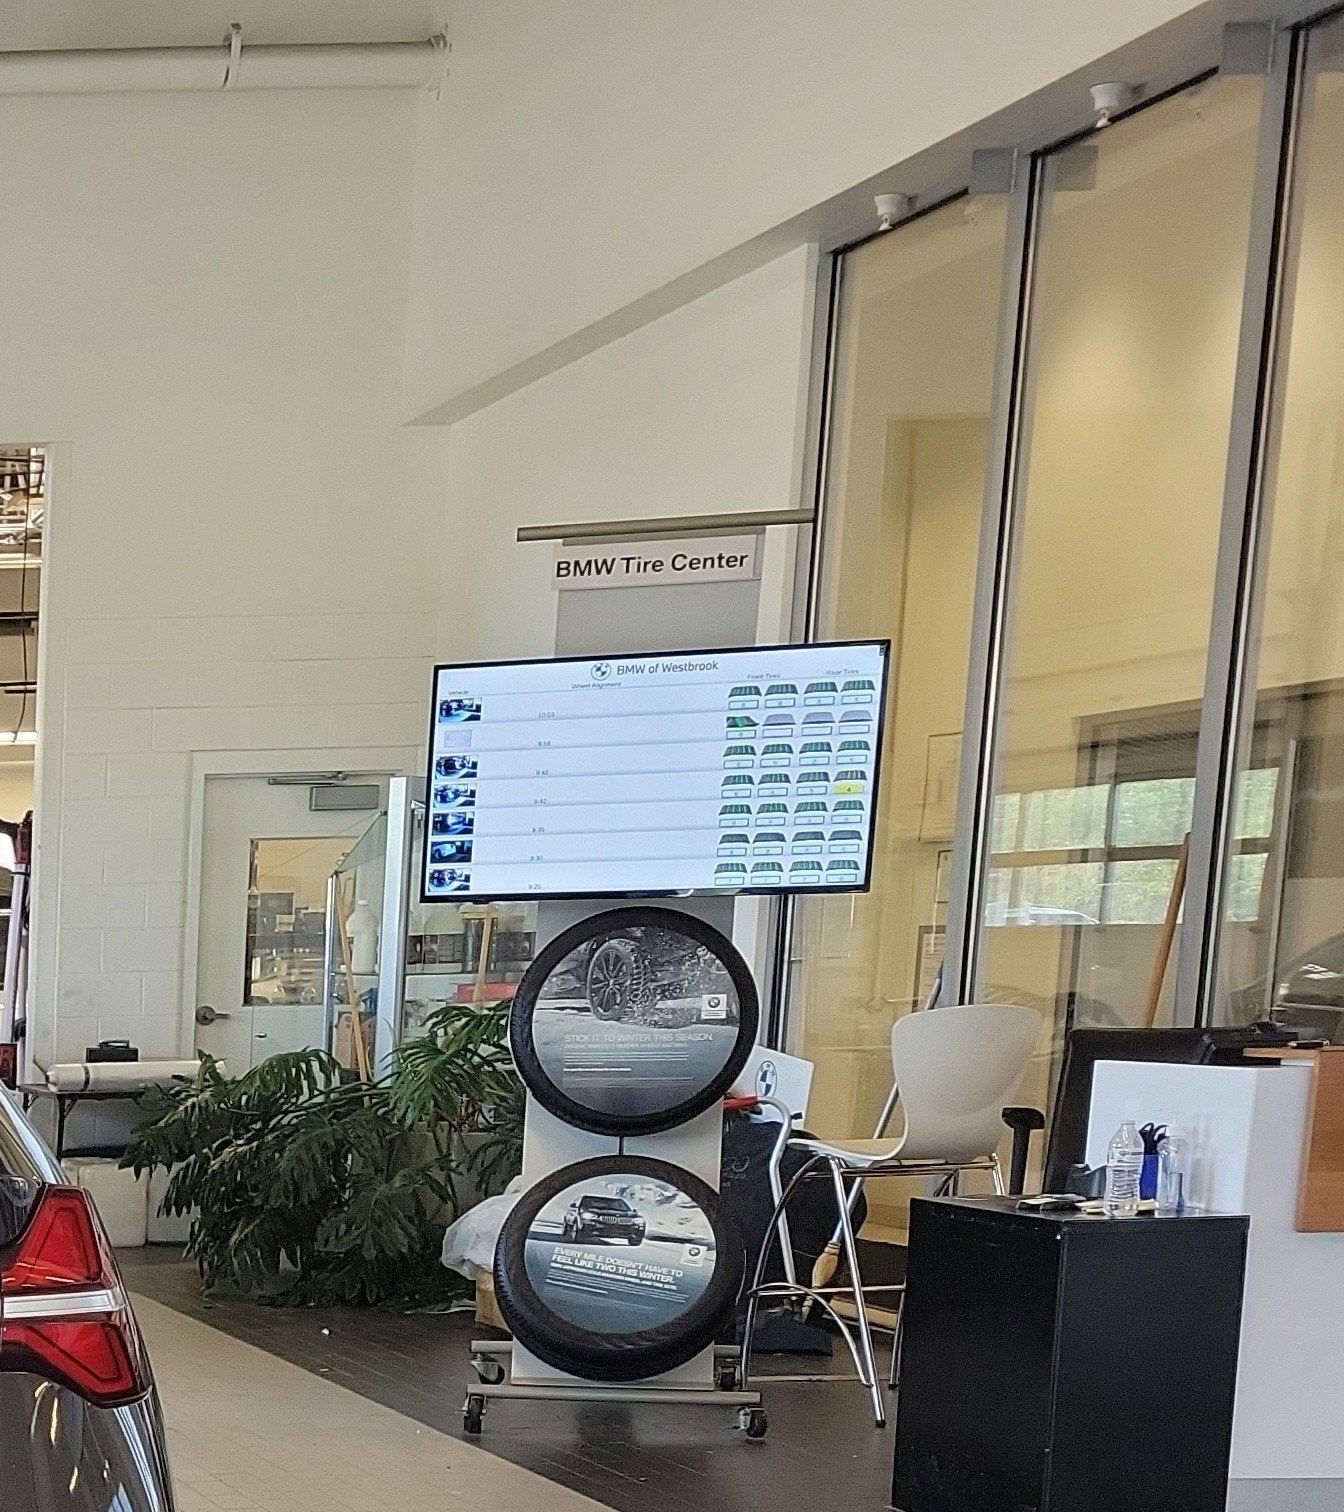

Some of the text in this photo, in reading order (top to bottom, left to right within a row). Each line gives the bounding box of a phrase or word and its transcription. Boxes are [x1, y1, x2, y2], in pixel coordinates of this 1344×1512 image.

[555, 552, 748, 578] BMW Tire Center
[616, 660, 719, 676] BMW of Westbrook
[554, 1247, 583, 1258] EVERY
[671, 1269, 684, 1278] TO
[575, 1258, 594, 1268] LIKE
[596, 1261, 616, 1272] TWO
[617, 1266, 638, 1276] THIS
